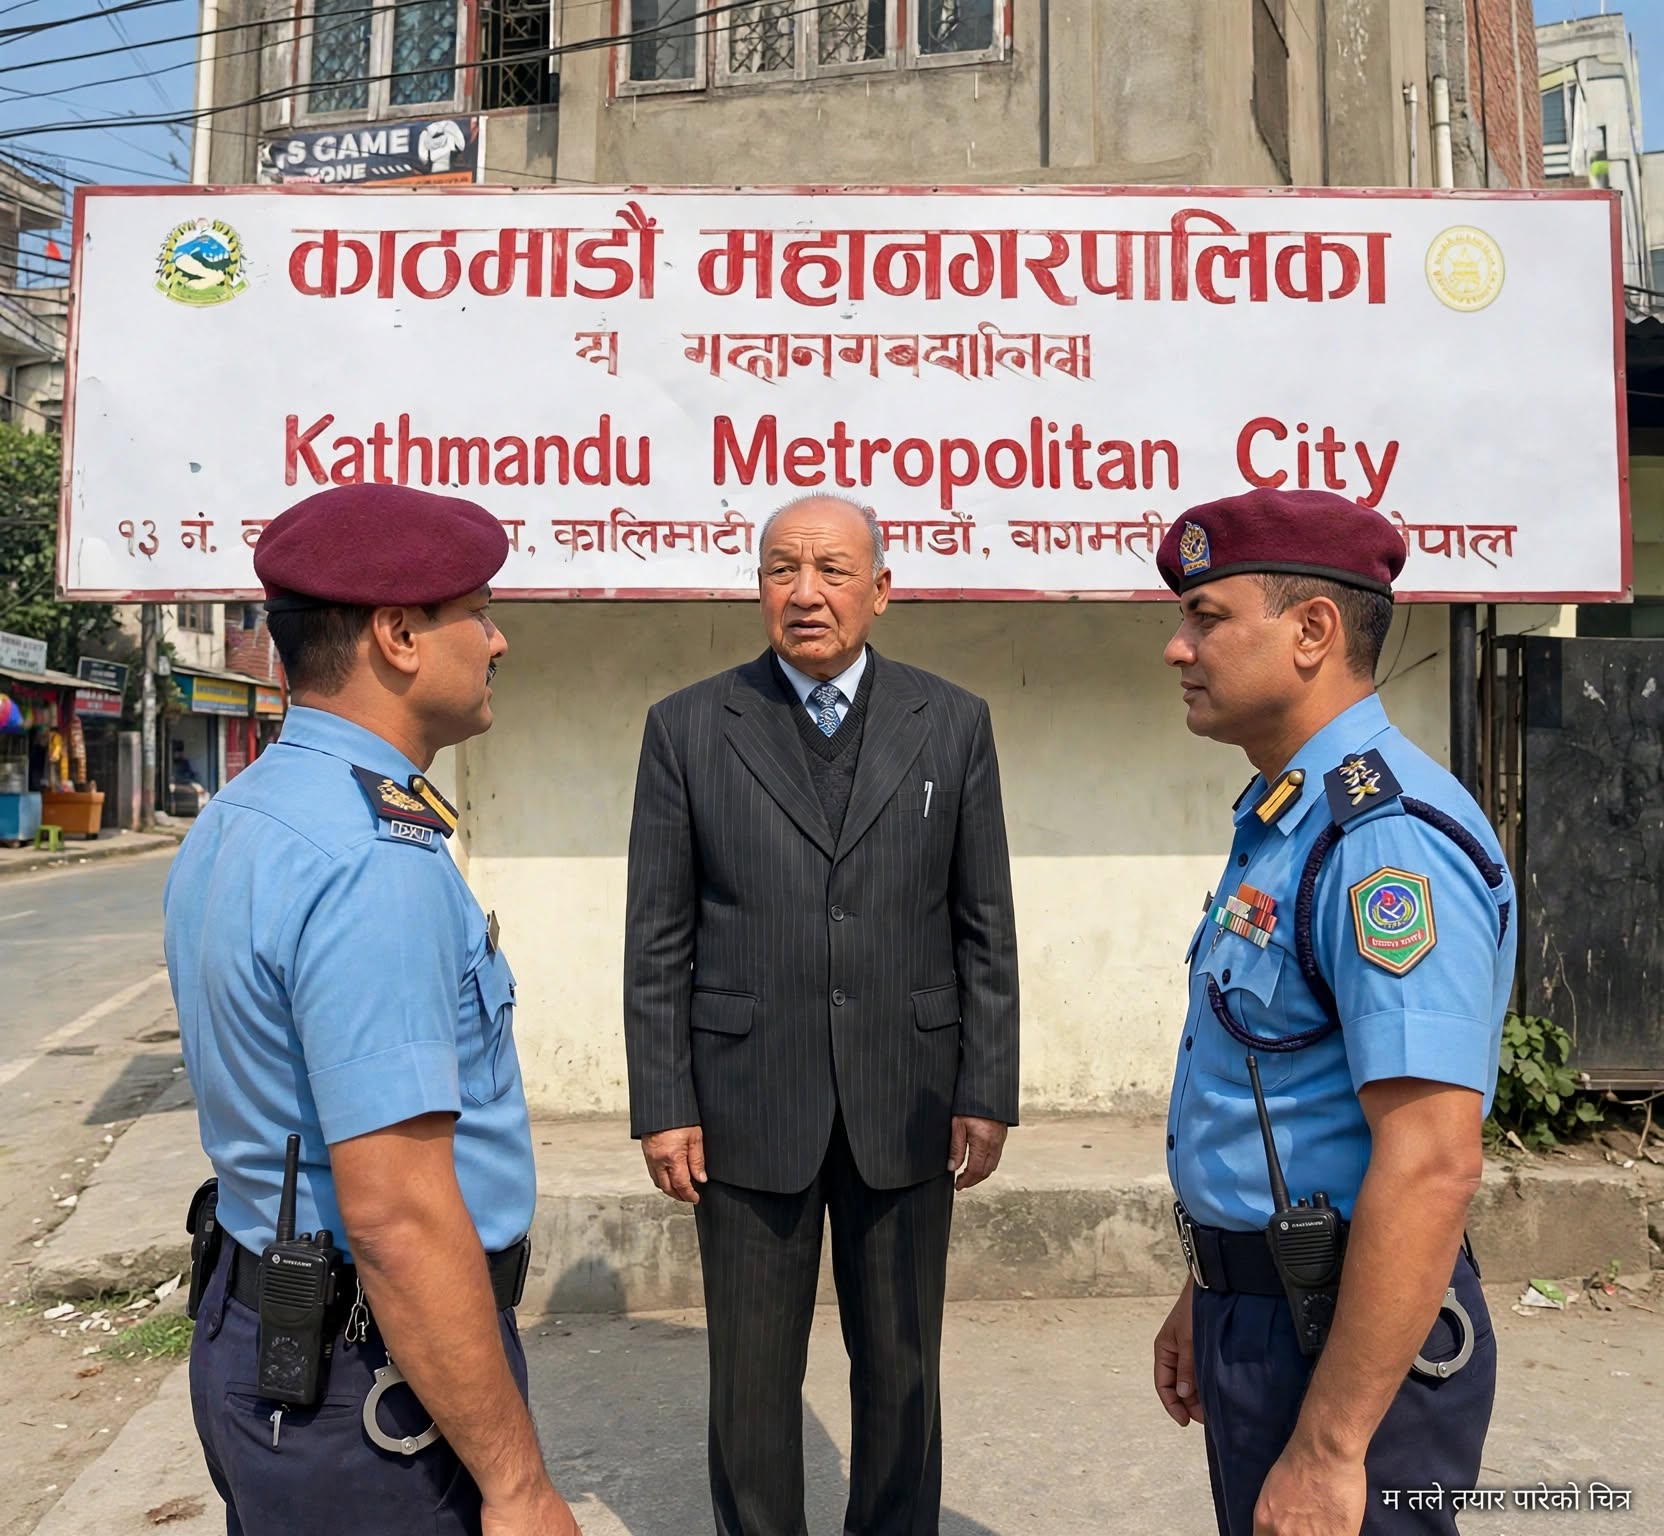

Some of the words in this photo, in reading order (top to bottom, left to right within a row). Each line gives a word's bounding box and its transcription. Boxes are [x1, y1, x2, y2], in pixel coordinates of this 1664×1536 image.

[312, 128, 410, 162] GAME
[289, 201, 664, 300] काठमाडौं
[697, 208, 1392, 306] महानगरपालिका
[285, 413, 651, 486] Kathmandu
[713, 415, 1180, 510] Metropolitan
[1236, 416, 1400, 508] City
[118, 519, 160, 561] १३
[552, 507, 755, 561] कालिमाटी
